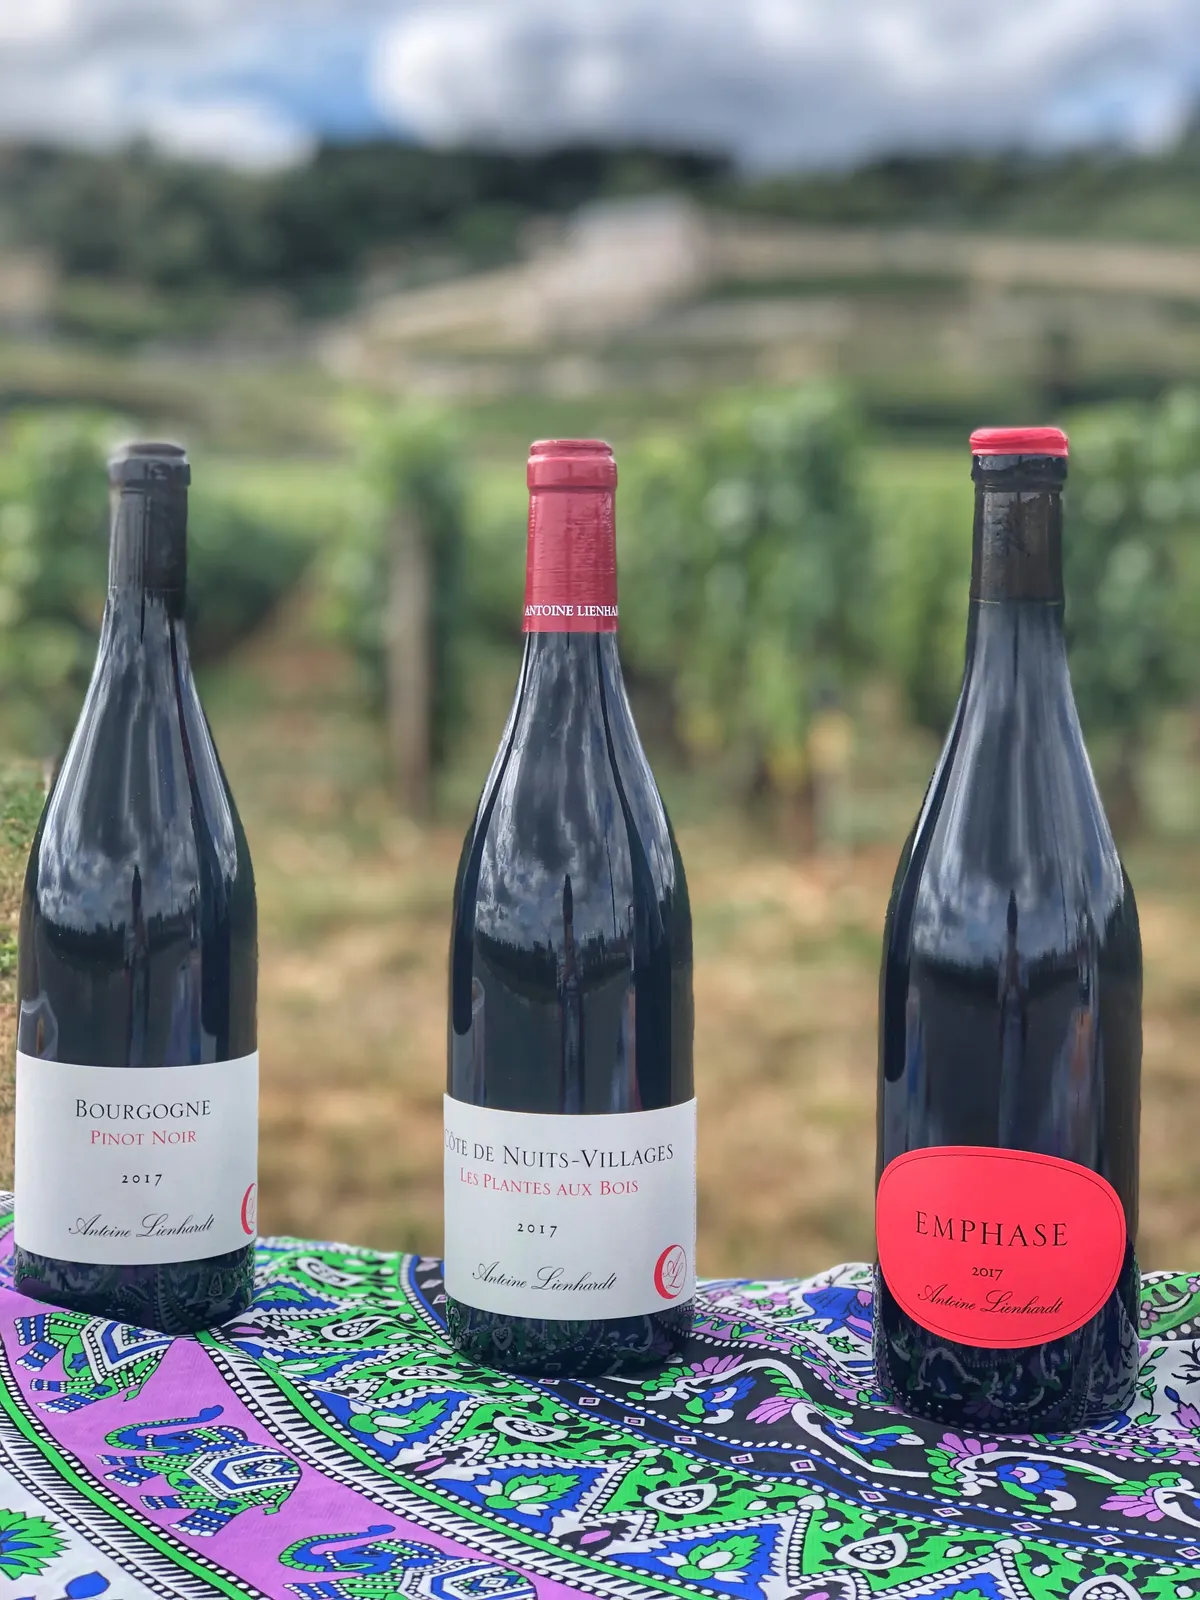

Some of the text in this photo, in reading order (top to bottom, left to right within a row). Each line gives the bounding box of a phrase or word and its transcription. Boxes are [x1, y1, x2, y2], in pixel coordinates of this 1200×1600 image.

[525, 604, 574, 616] ANTOINE
[75, 1098, 211, 1120] BOURGOGNE
[90, 1130, 197, 1145] PINOT NOIR
[444, 1128, 674, 1169] CÔTE DE NUITS-VILLAGES
[121, 1173, 163, 1187] 2017
[460, 1167, 639, 1196] LES PLANTES AUX BOIS
[68, 1212, 215, 1239] Antoine Lienhardt
[516, 1223, 558, 1238] 2017
[915, 1210, 1069, 1248] EMPHASE
[472, 1261, 618, 1292] Antoine Lienhardt
[971, 1266, 1004, 1281] 2017
[917, 1284, 1064, 1315] Antoine Lienhardt
